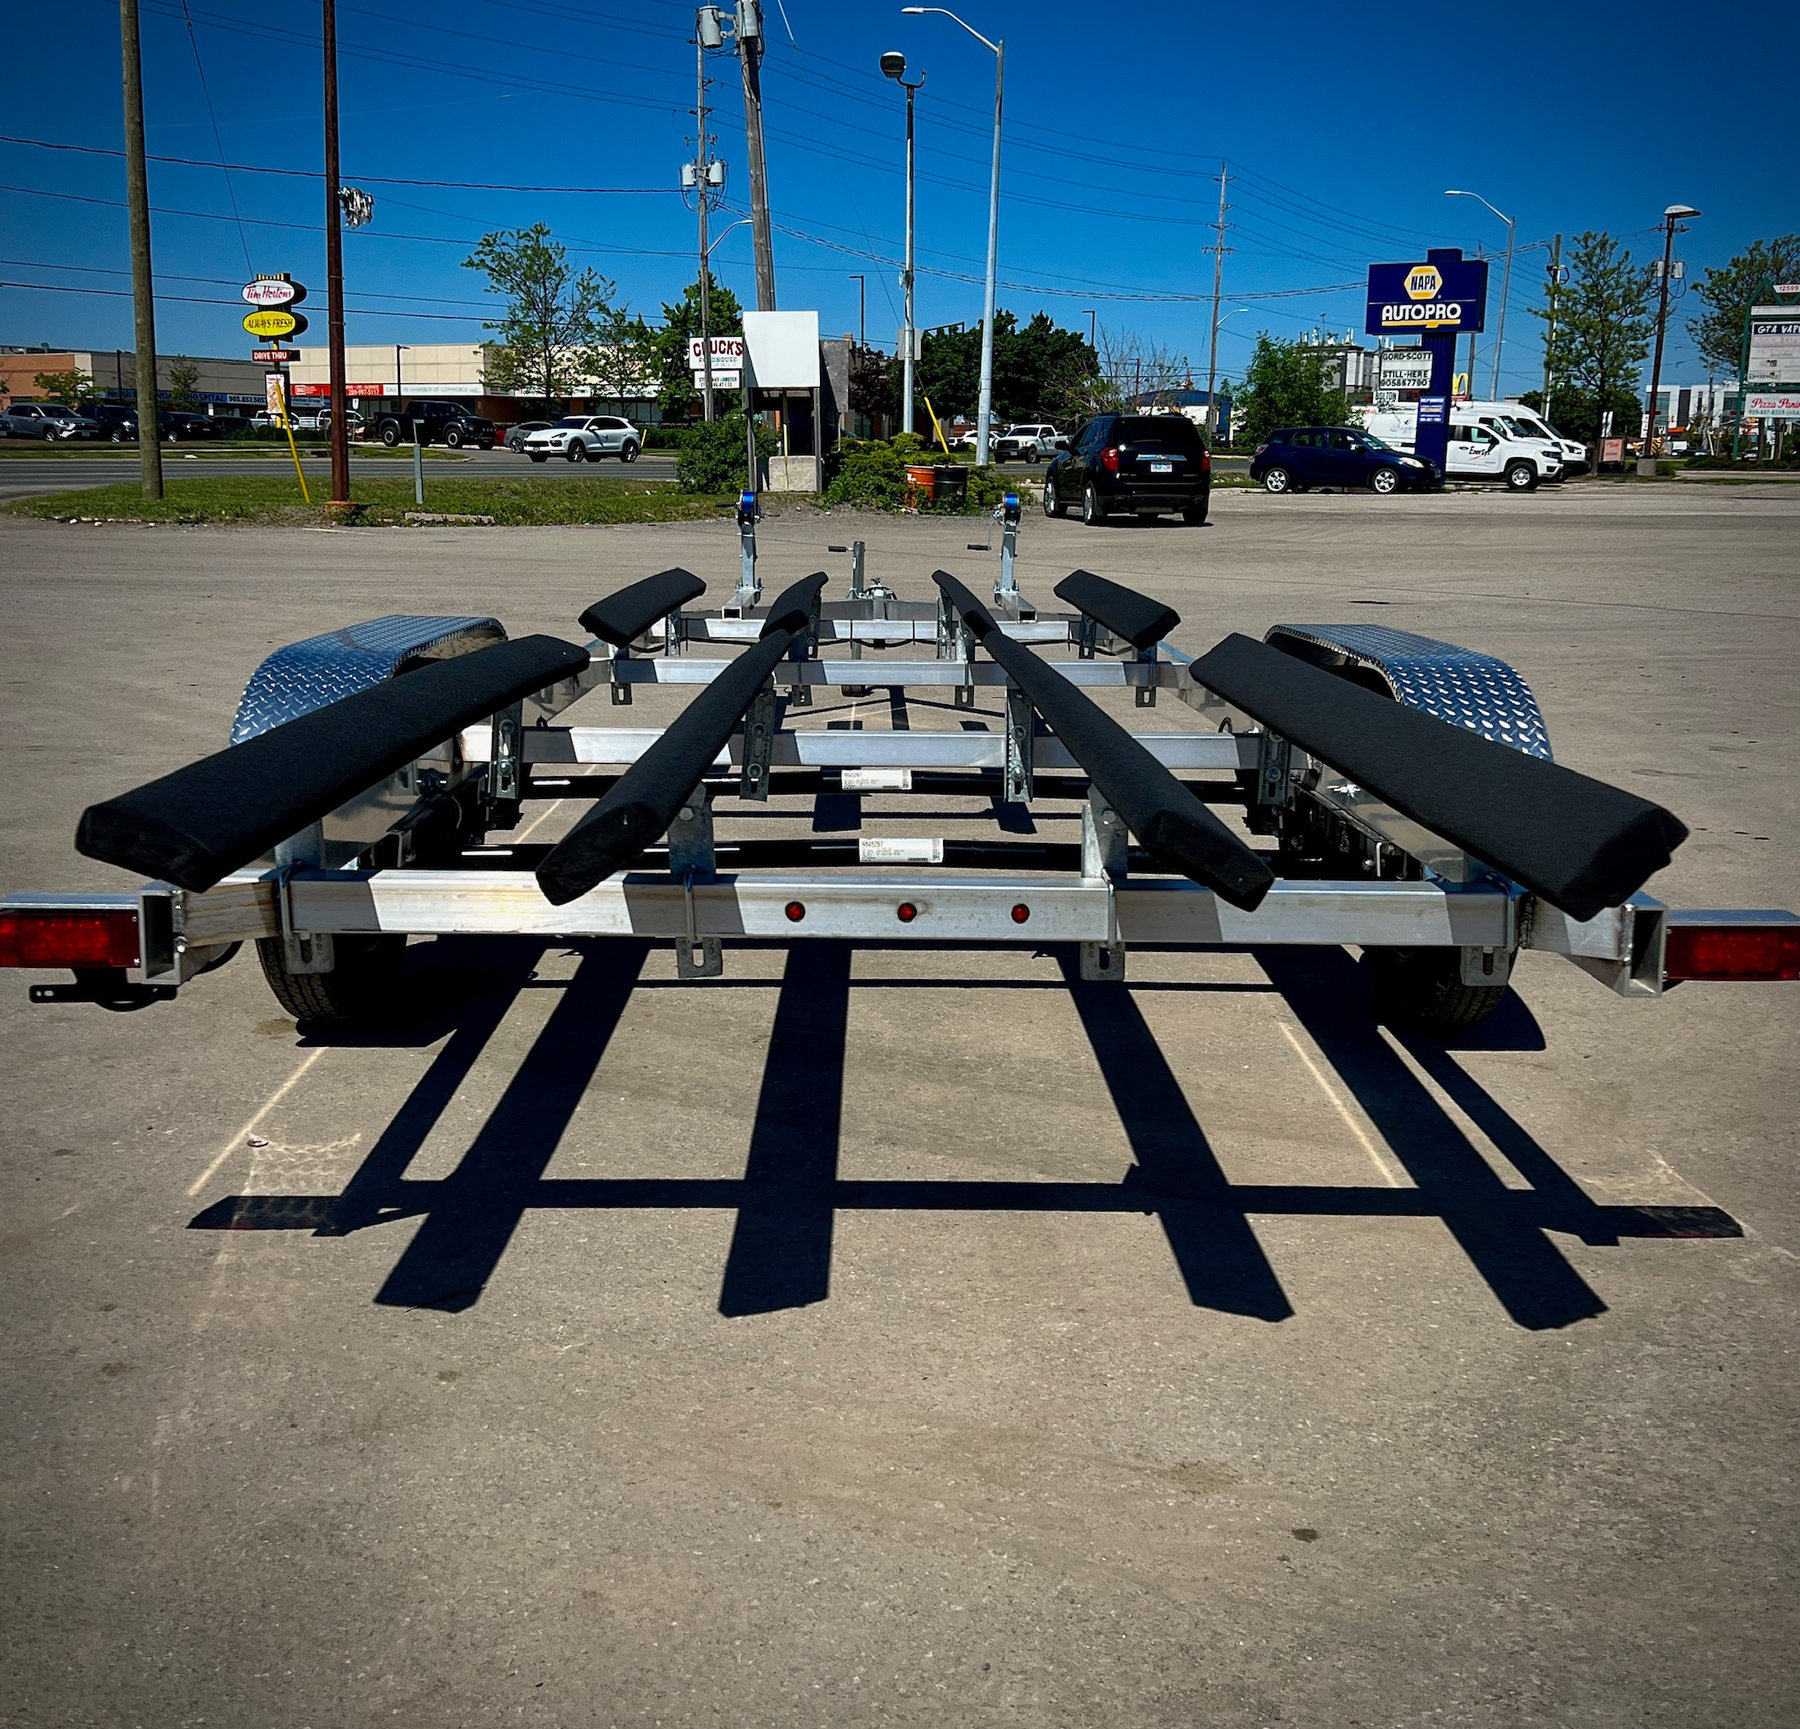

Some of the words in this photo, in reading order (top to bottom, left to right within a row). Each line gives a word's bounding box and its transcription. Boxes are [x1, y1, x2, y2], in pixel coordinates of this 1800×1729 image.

[1410, 275, 1436, 291] NAPA
[246, 285, 261, 299] Tim
[261, 285, 292, 299] Hortons
[1381, 303, 1462, 321] AUTOPRO
[247, 318, 272, 329] ALWAYS
[272, 318, 293, 328] FRESH
[1757, 324, 1778, 334] GTA
[693, 340, 744, 357] CUCK'S
[253, 351, 271, 360] DRIVE
[271, 352, 288, 360] THRU
[1382, 352, 1431, 360] GORD-SCOTT
[1382, 370, 1429, 378] STILL-HERE
[187, 393, 225, 402] HOSPITAL
[1751, 398, 1776, 409] Pizza
